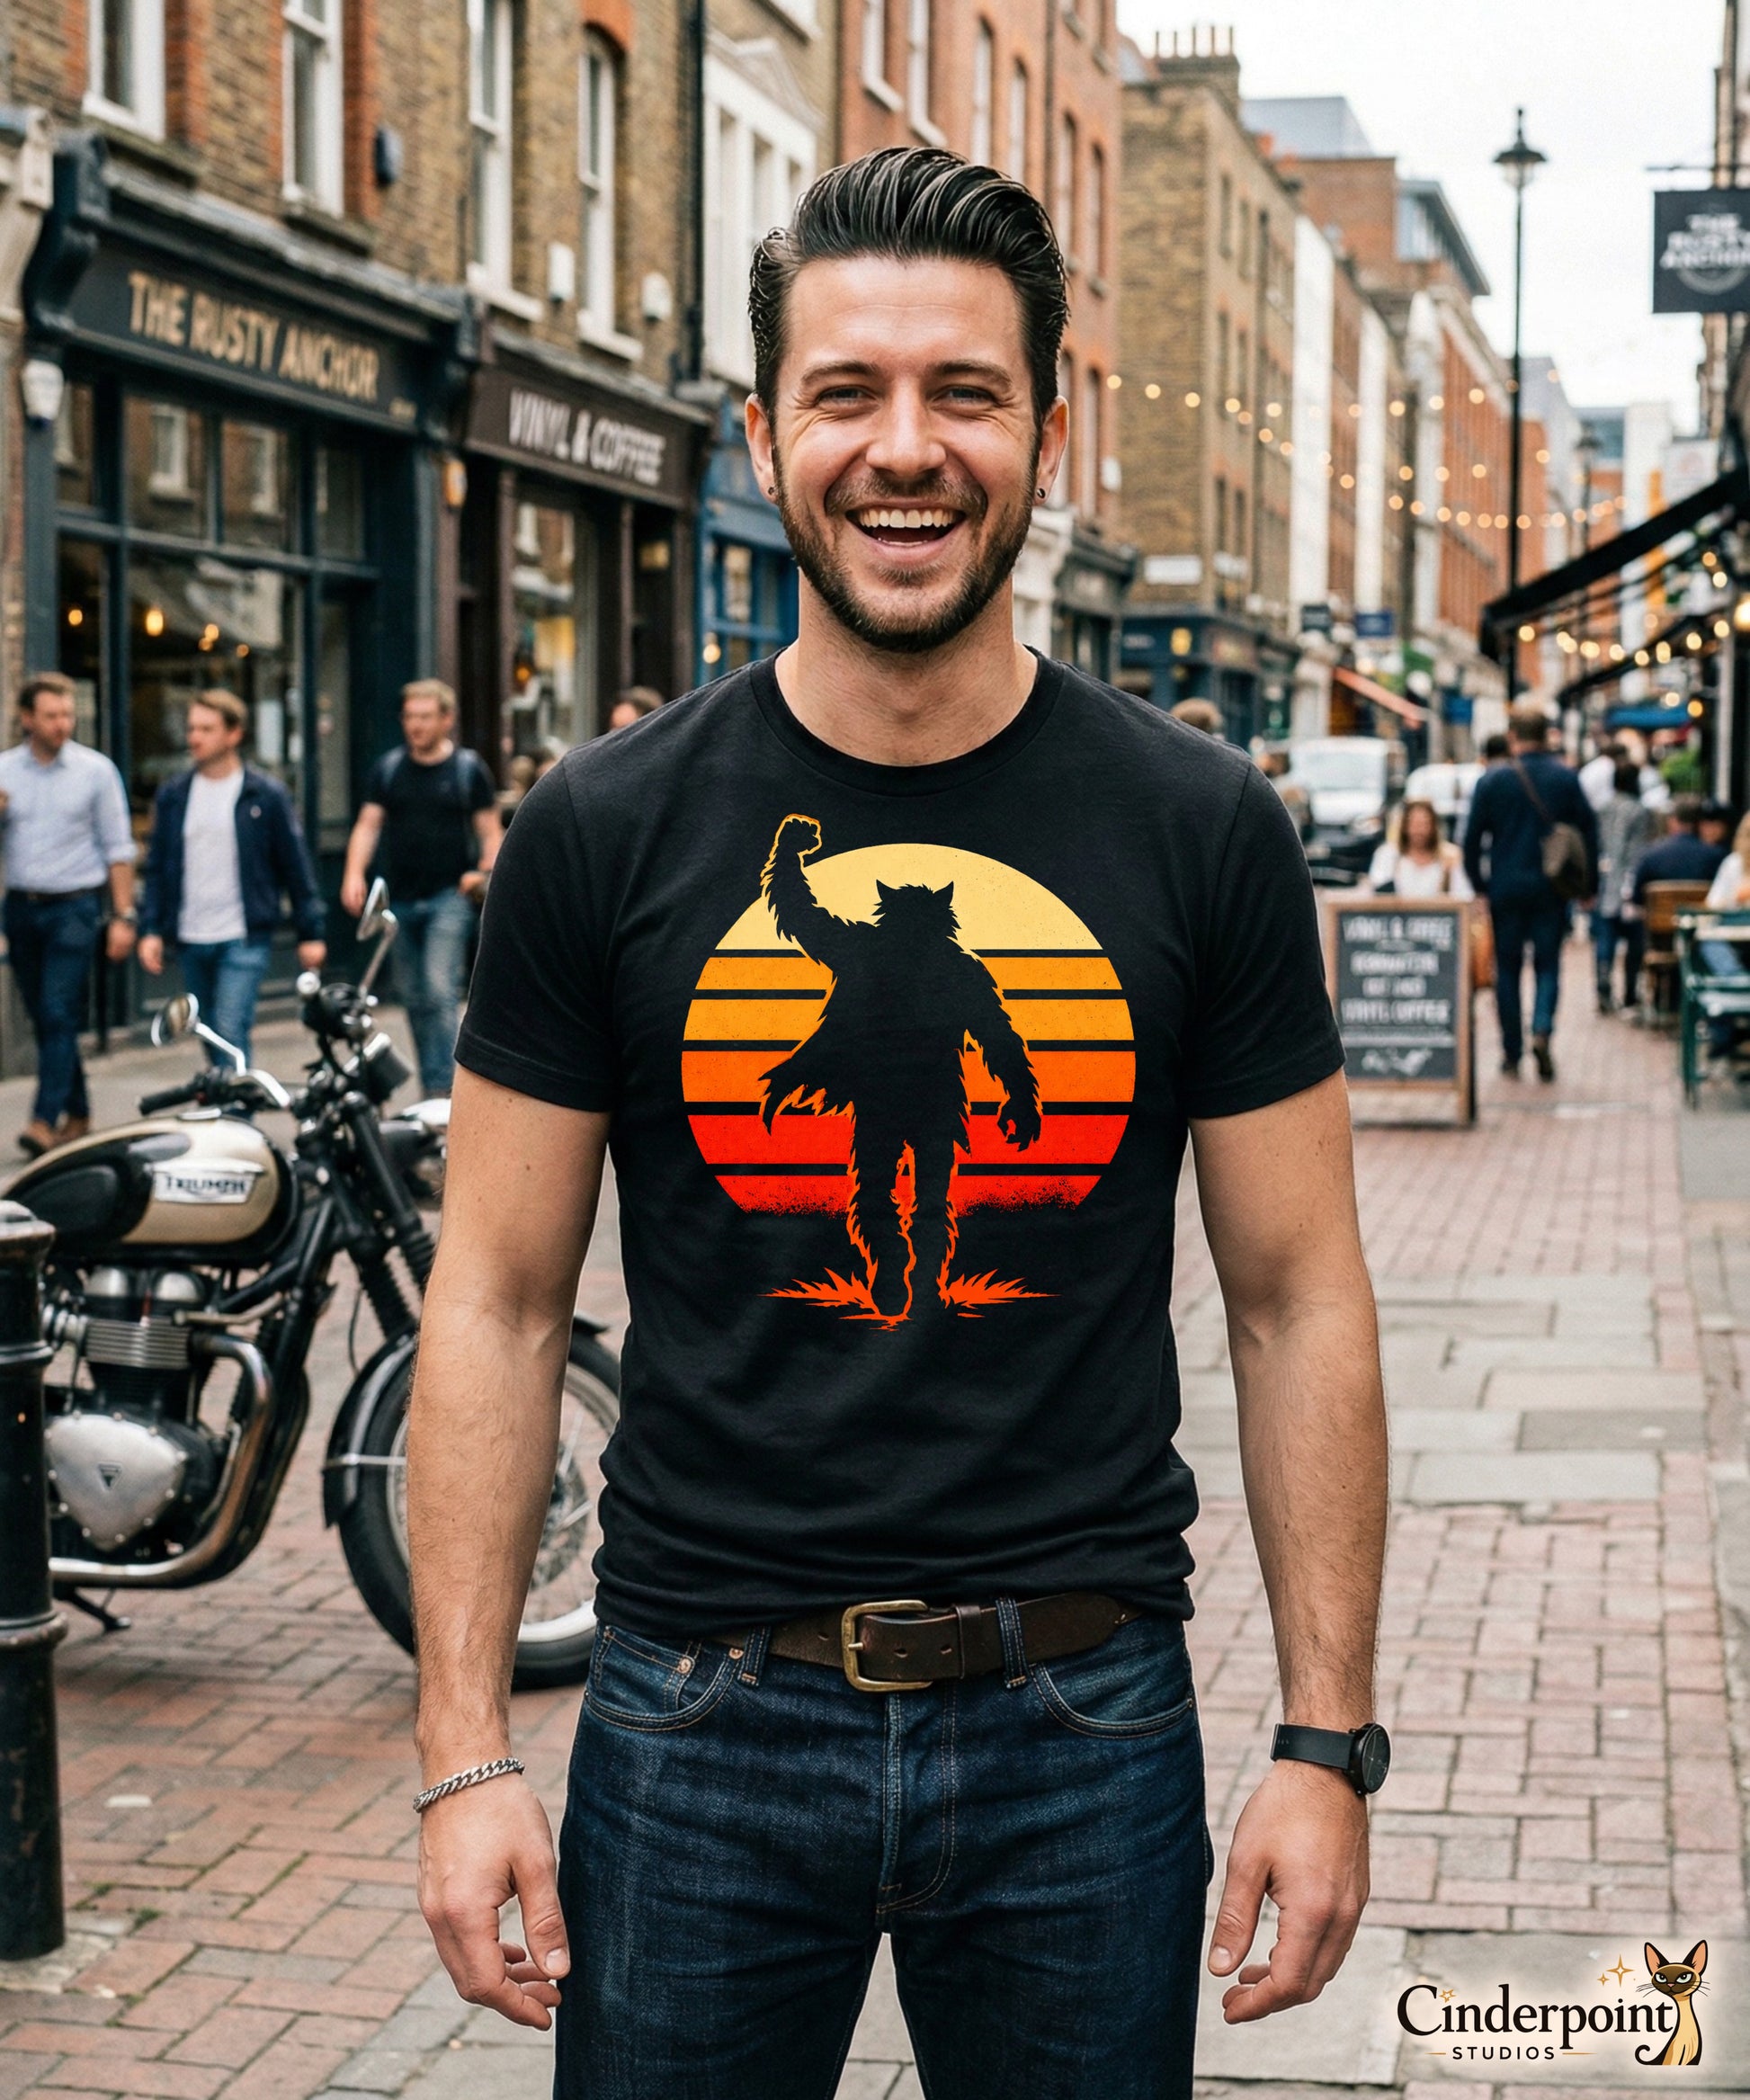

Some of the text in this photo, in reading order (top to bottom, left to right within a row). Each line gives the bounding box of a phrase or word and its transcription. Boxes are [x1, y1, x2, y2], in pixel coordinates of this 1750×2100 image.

[1687, 213, 1740, 232] THE
[129, 270, 379, 403] THE RUSTY ANCHOR
[508, 388, 666, 487] VINYL & COFFEE
[165, 1175, 246, 1193] TRIUMPH
